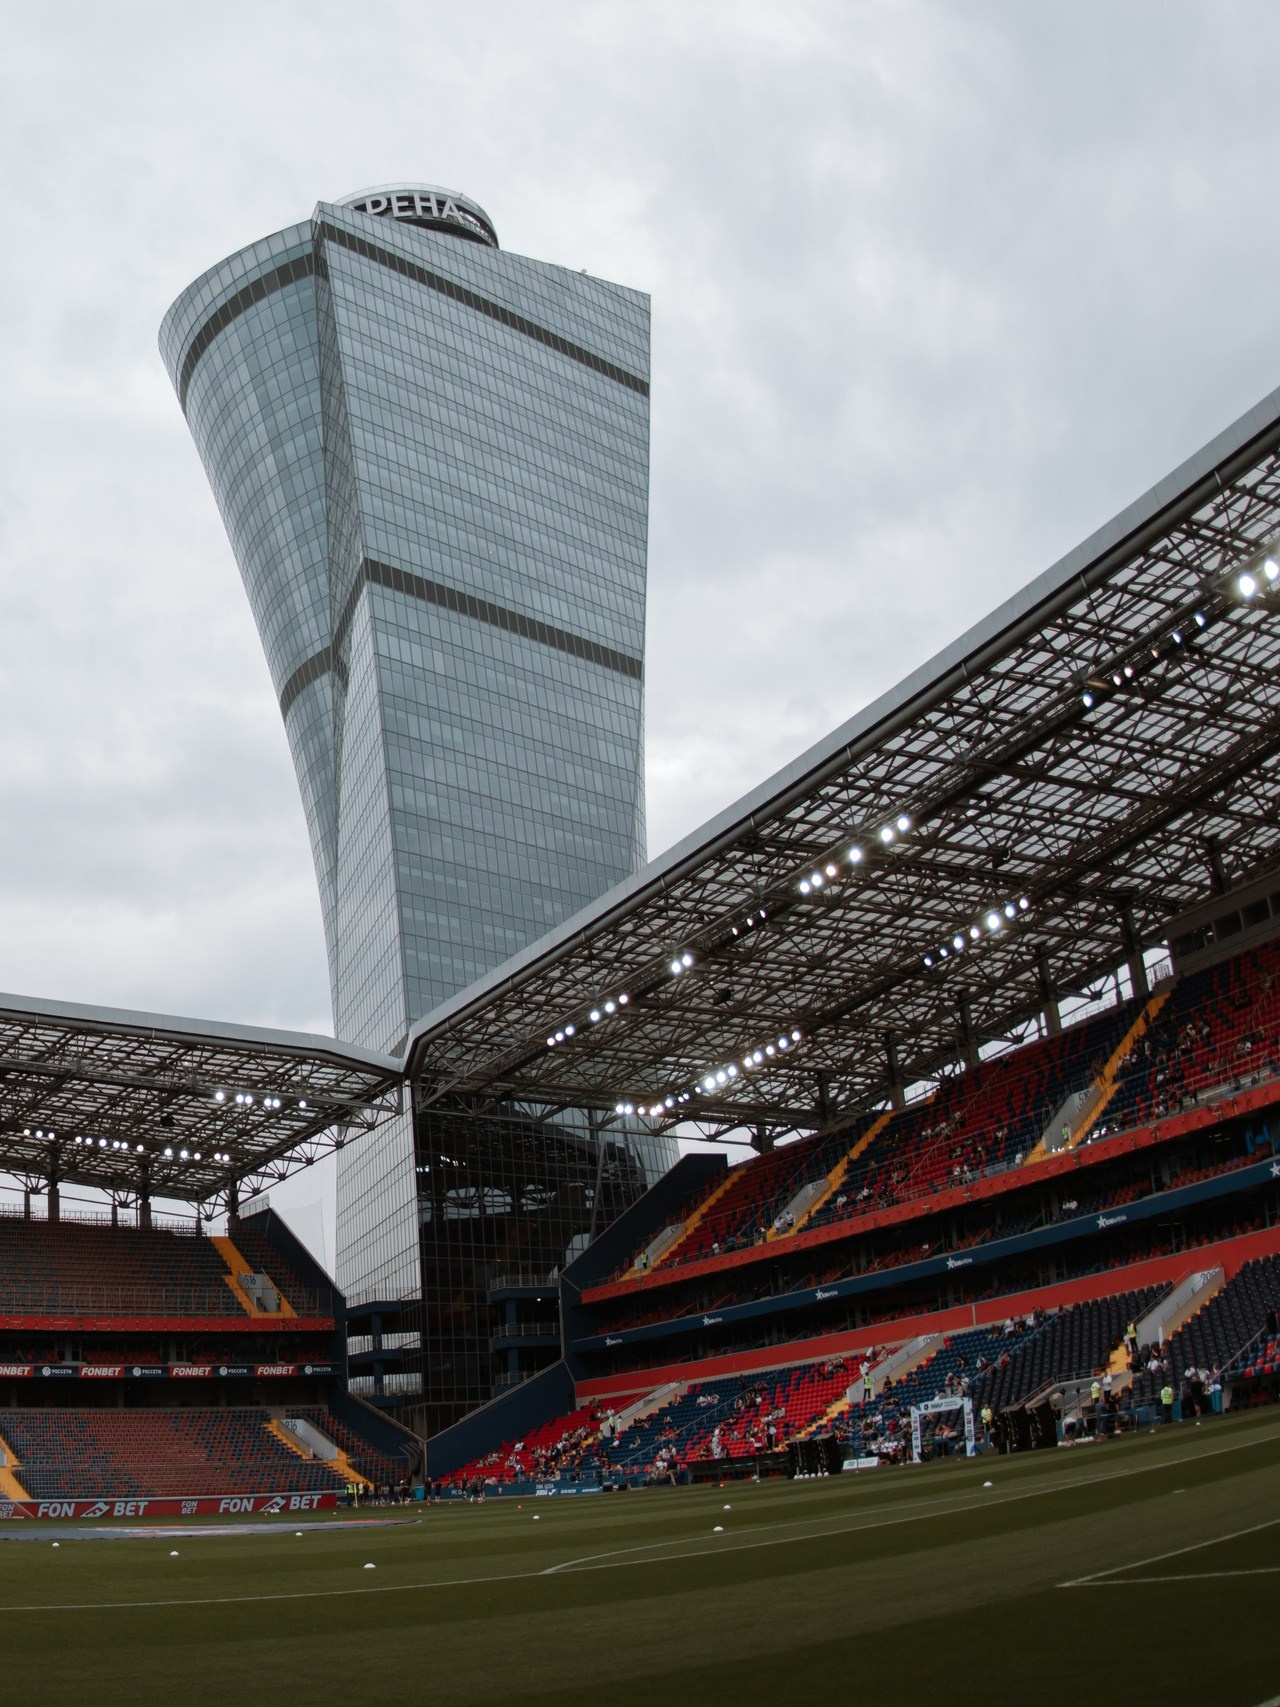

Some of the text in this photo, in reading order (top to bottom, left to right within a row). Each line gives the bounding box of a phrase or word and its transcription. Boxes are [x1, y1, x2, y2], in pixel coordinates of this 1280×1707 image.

[348, 192, 465, 224] РЕНА
[81, 1367, 121, 1376] FONBET
[172, 1367, 211, 1376] FONBET
[257, 1366, 294, 1375] FONBET
[37, 1501, 148, 1518] FON BET
[219, 1495, 321, 1513] FON BET
